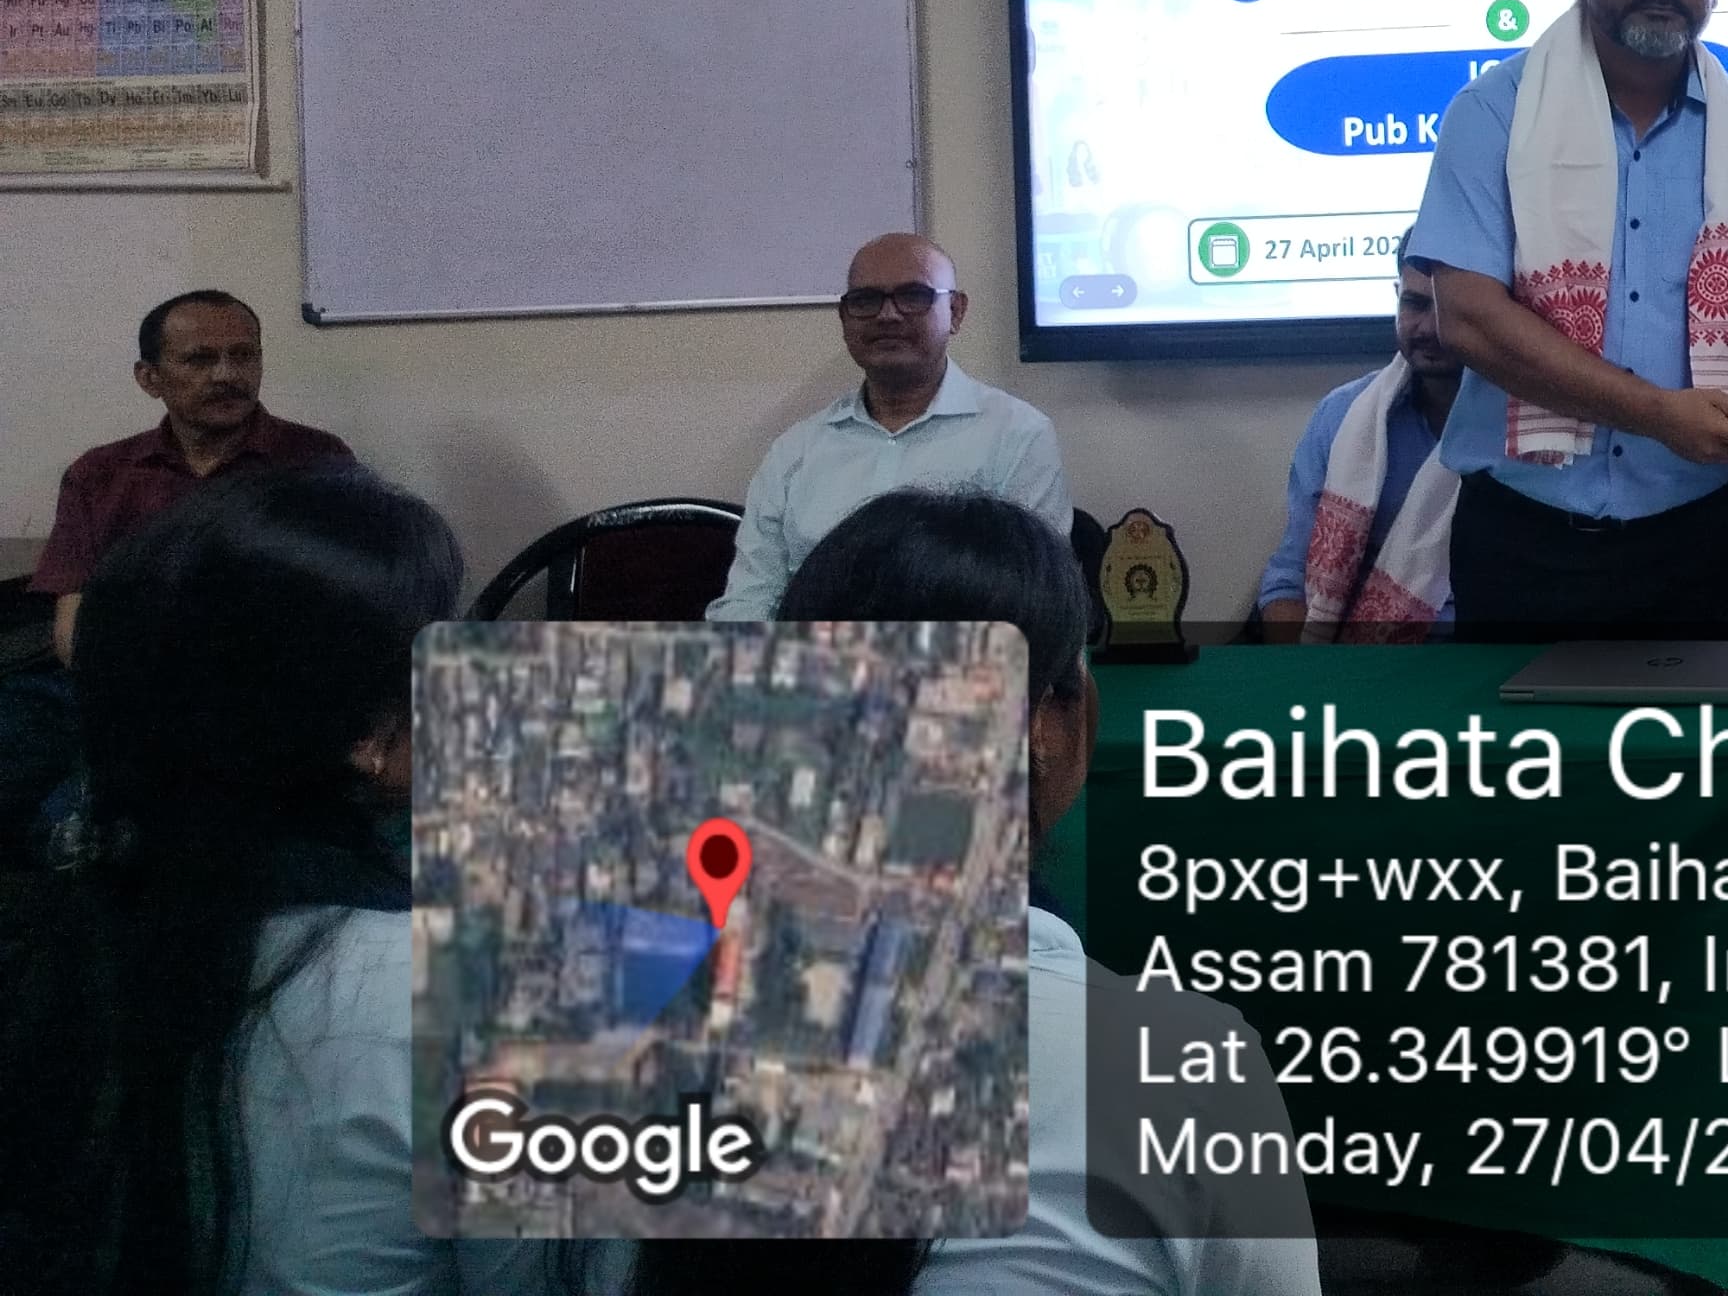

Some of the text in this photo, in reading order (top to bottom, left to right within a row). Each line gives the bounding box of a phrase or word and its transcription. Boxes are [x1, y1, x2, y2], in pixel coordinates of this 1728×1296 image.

[54, 22, 70, 36] Au
[176, 18, 191, 32] Po
[1497, 7, 1518, 31] &
[228, 88, 242, 102] Lu
[1344, 113, 1408, 147] Pub
[1265, 236, 1402, 263] 27 April 202
